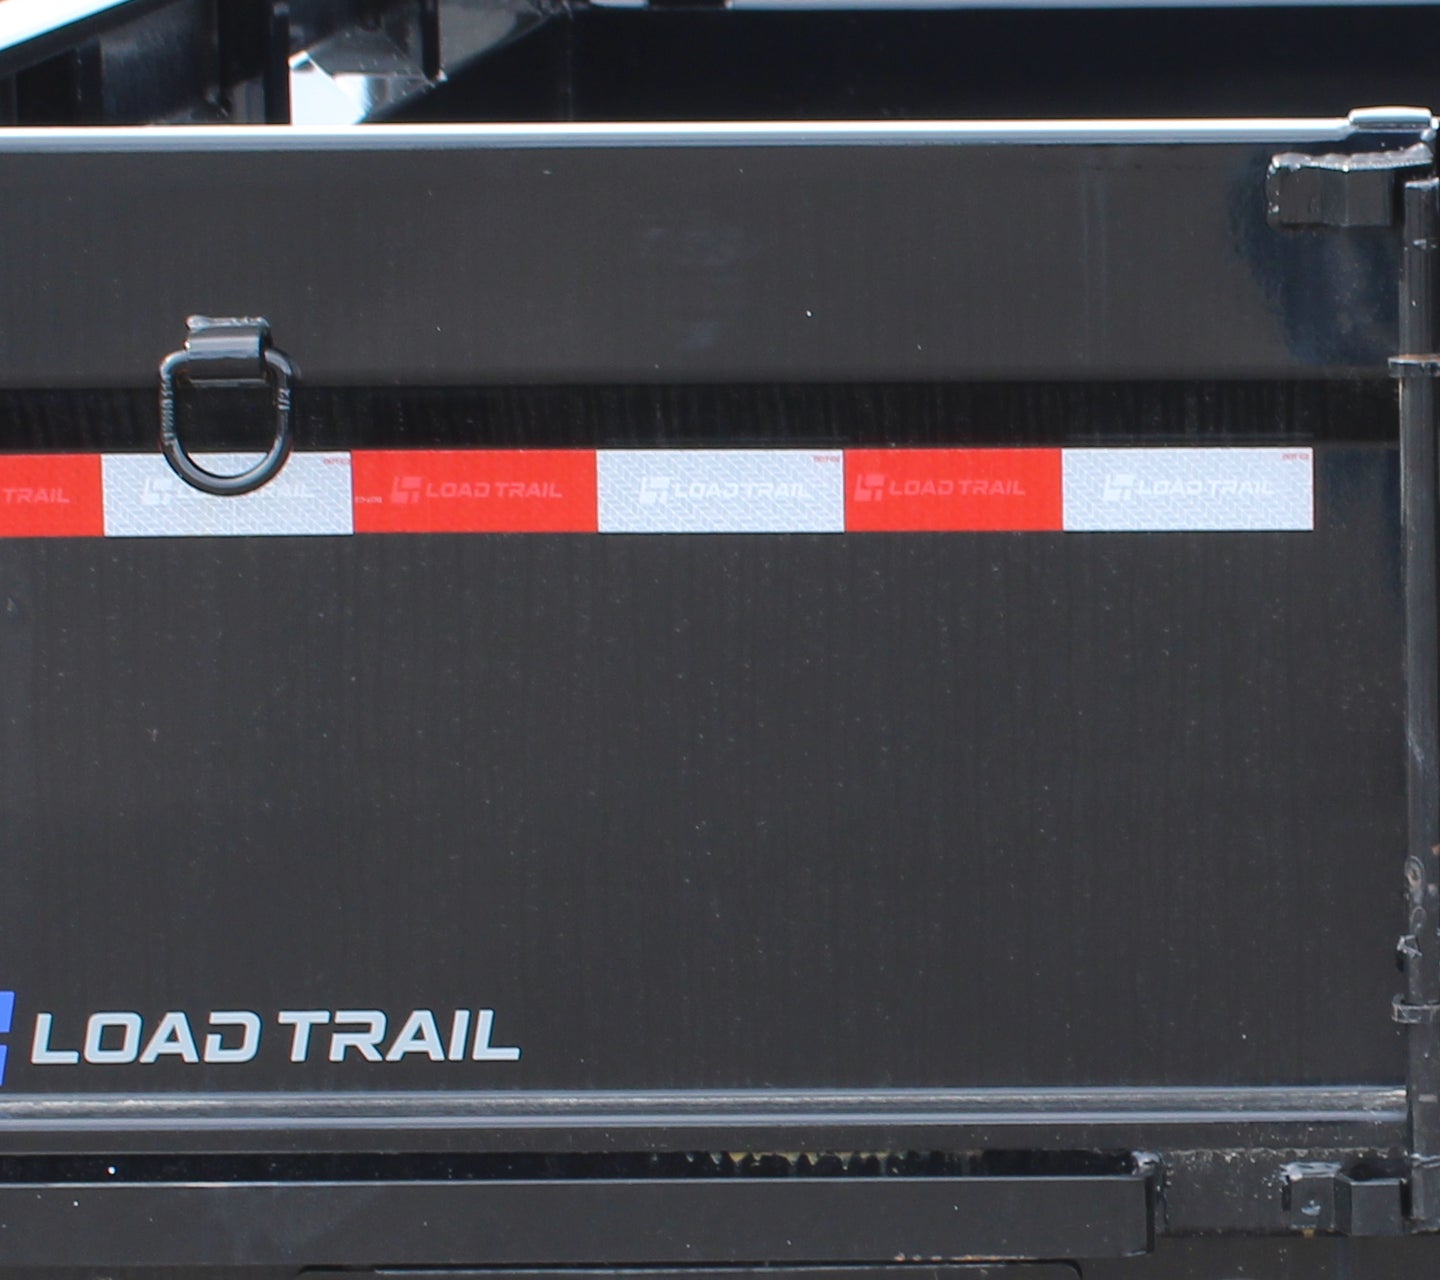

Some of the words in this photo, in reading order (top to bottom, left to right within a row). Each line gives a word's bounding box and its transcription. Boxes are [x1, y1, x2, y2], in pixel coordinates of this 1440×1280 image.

[426, 482, 491, 498] LOAD
[495, 482, 563, 498] TRAIL
[674, 482, 740, 498] LOAD
[743, 482, 811, 498] TRAIL
[888, 480, 954, 496] LOAD
[958, 479, 1026, 496] TRAIL
[1137, 479, 1204, 495] LOAD
[1207, 479, 1275, 495] TRAIL
[2, 487, 70, 504] TRAIL
[30, 1010, 262, 1065] LOAD
[277, 1008, 522, 1062] TRAIL
